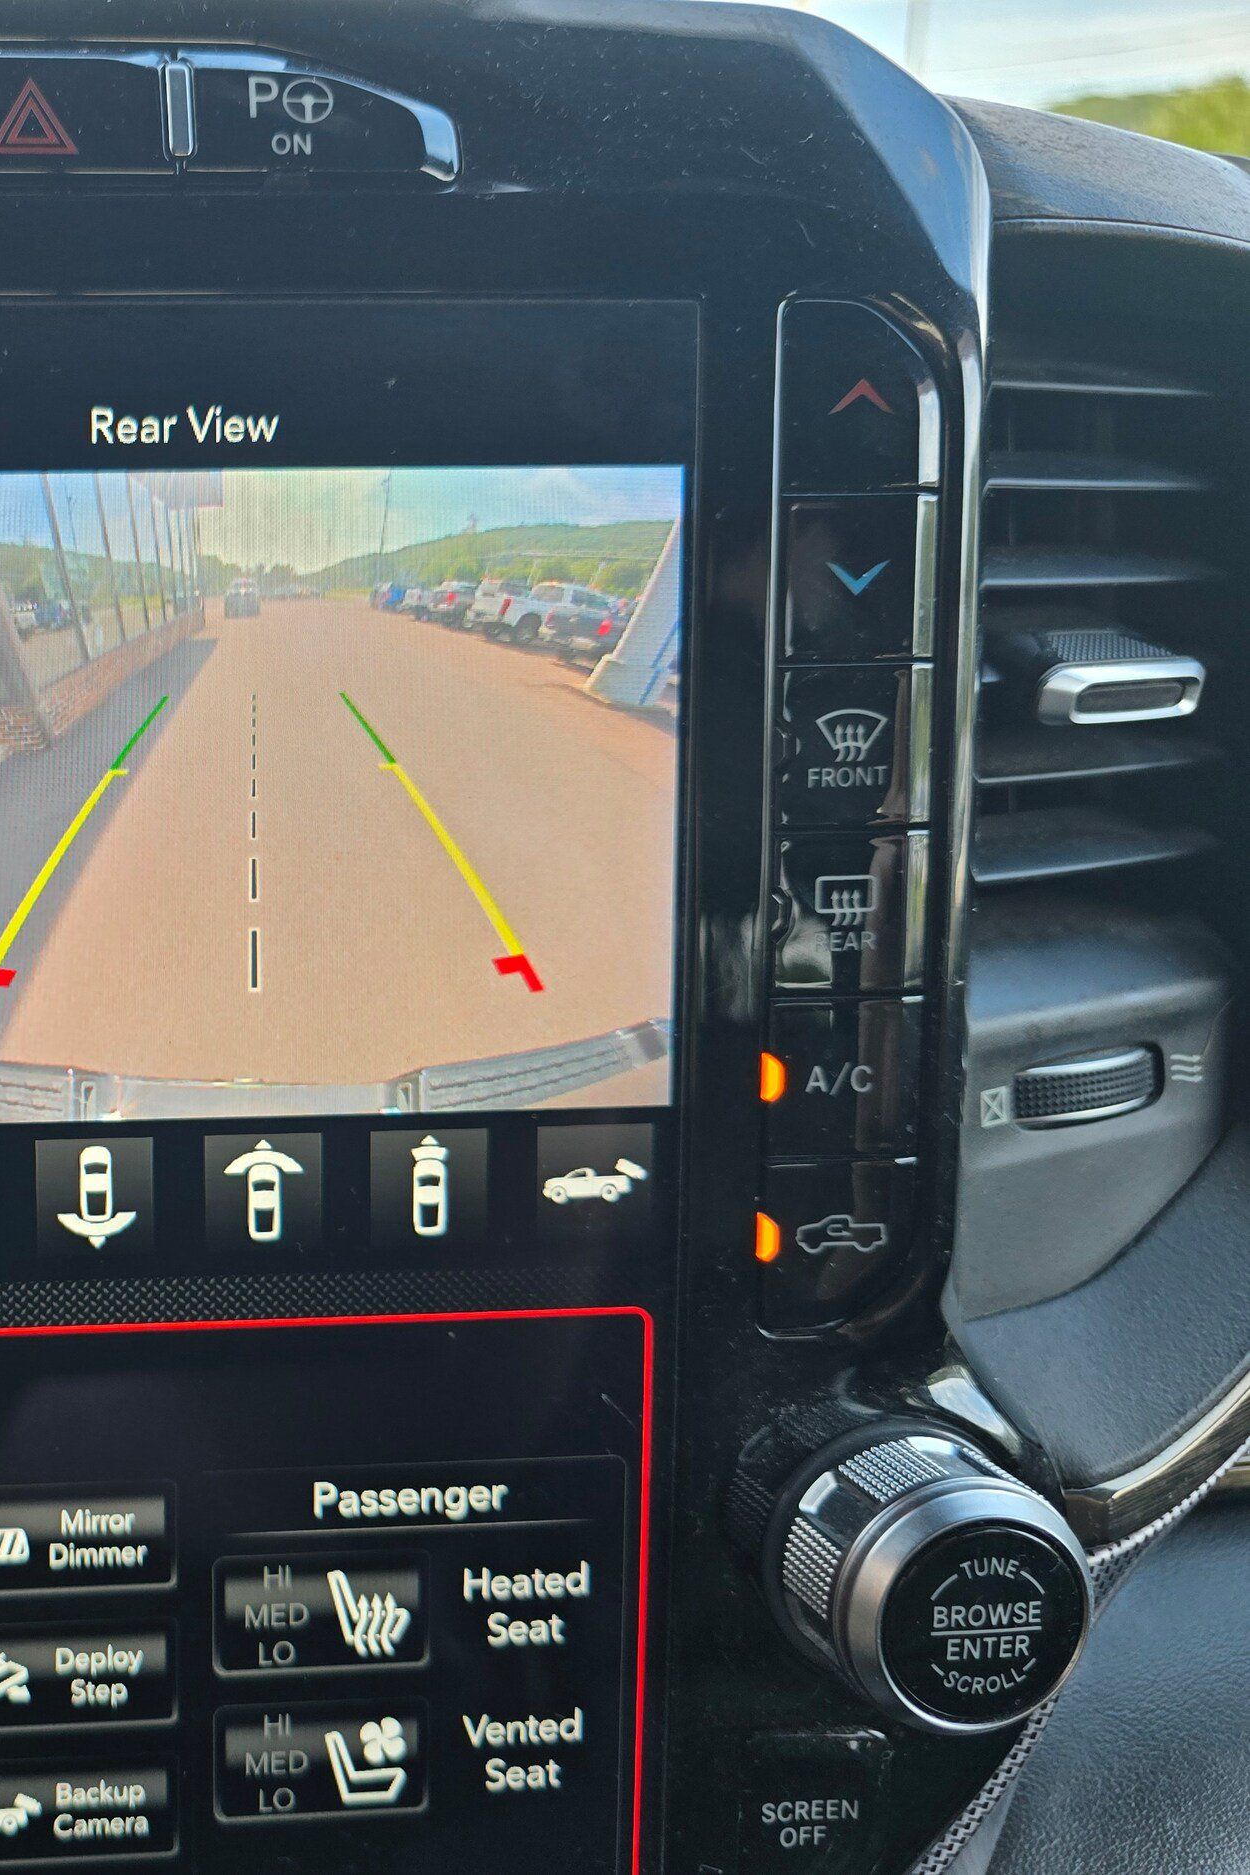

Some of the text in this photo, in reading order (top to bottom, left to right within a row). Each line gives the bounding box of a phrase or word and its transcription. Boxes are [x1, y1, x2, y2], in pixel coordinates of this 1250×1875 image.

[271, 133, 312, 155] ON
[90, 405, 279, 445] Rear View
[808, 765, 888, 789] FRONT
[815, 931, 877, 952] REAR
[805, 1062, 874, 1095] A/C
[313, 1481, 508, 1521] Passenger
[60, 1508, 136, 1535] Mirror
[49, 1542, 148, 1570] Dimmer
[959, 1556, 1021, 1581] TUNE
[262, 1565, 292, 1591] HI
[463, 1560, 590, 1601] Heated
[244, 1602, 309, 1629] MED
[932, 1600, 1042, 1628] BROWSE
[487, 1611, 565, 1647] Seat
[55, 1645, 144, 1676] Deploy
[258, 1641, 296, 1668] LO
[946, 1635, 1031, 1661] ENTER
[70, 1677, 128, 1708] Step
[942, 1668, 1028, 1696] SCROLL
[262, 1713, 292, 1738] HI
[462, 1706, 583, 1748] Vented
[244, 1750, 309, 1777] MED
[485, 1757, 561, 1792] Seat
[55, 1779, 146, 1810] Backup
[258, 1788, 296, 1814] LO
[761, 1799, 859, 1824] SCREEN
[53, 1813, 149, 1840] Camera
[779, 1825, 827, 1849] OFF
